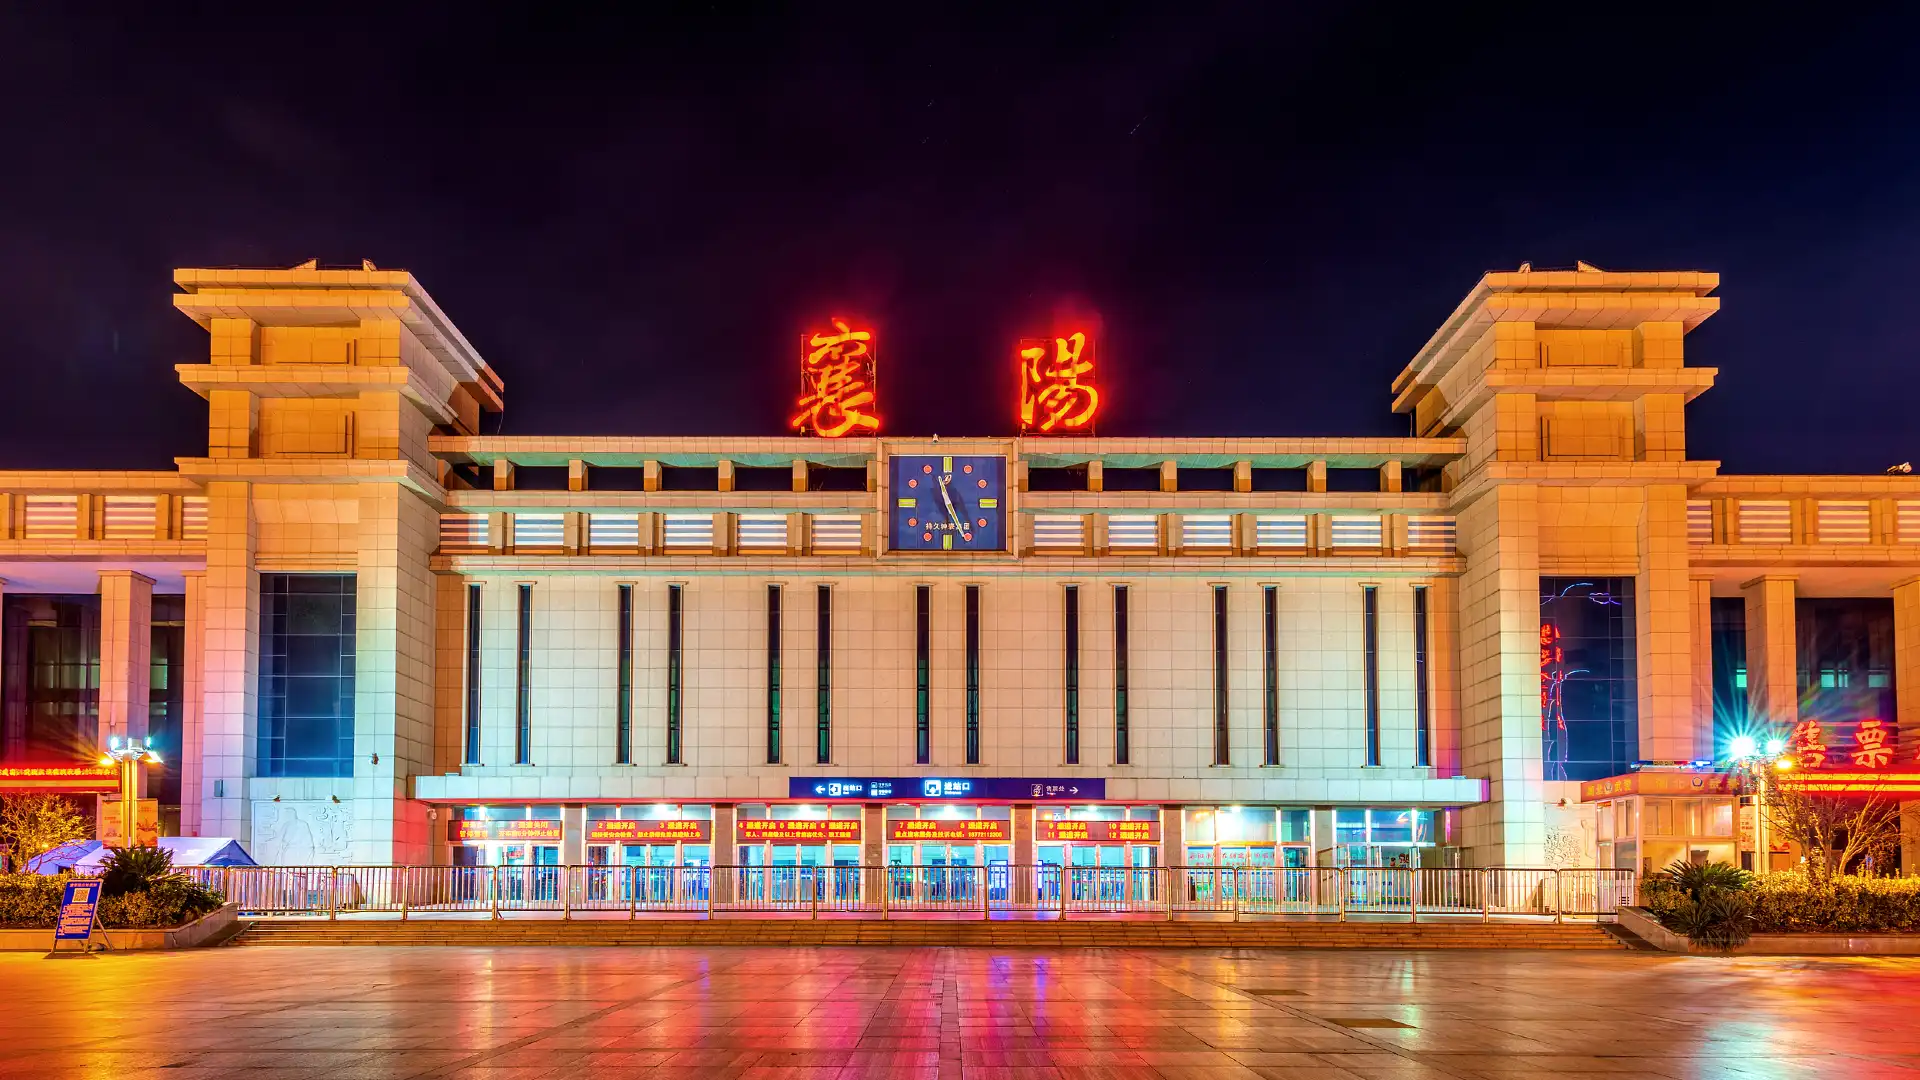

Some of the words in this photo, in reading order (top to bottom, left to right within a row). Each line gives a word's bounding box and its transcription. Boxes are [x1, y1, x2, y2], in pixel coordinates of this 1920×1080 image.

[1789, 719, 1920, 768] 售票
[944, 782, 970, 791] 进站口
